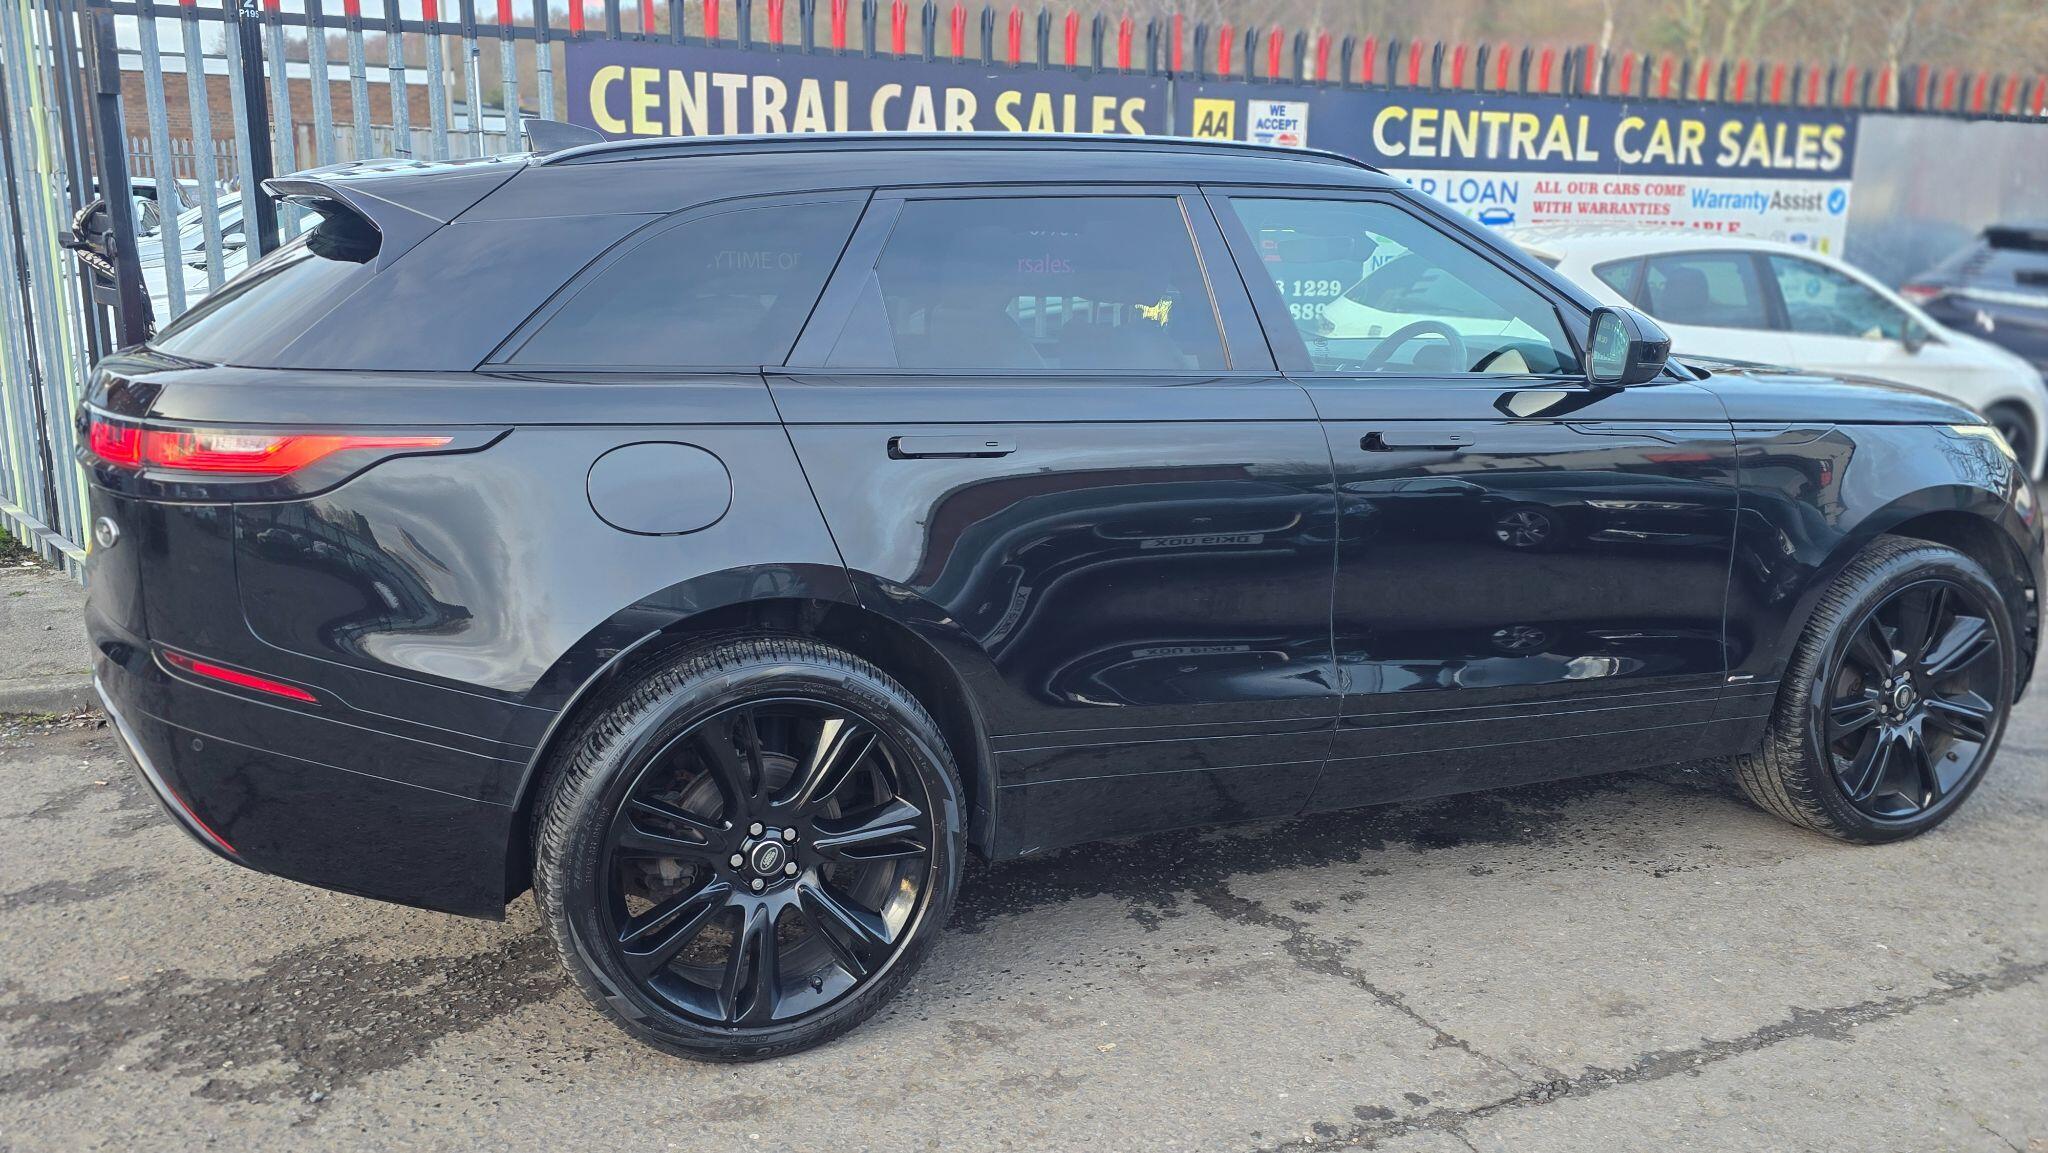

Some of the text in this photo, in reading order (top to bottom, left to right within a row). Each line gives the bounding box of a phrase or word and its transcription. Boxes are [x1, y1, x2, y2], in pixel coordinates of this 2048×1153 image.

[589, 65, 1146, 137] CENTRAL CAR SALES
[1270, 104, 1286, 117] WE
[1198, 110, 1228, 137] AA
[1256, 118, 1298, 130] ACCEPT
[1372, 105, 1846, 171] CENTRAL CAR SALES
[1446, 178, 1519, 204] LOAN
[1534, 181, 1686, 197] ALL OUR CARS COME
[1533, 201, 1671, 216] WITH WARRANTIES
[1292, 280, 1341, 297] 1229
